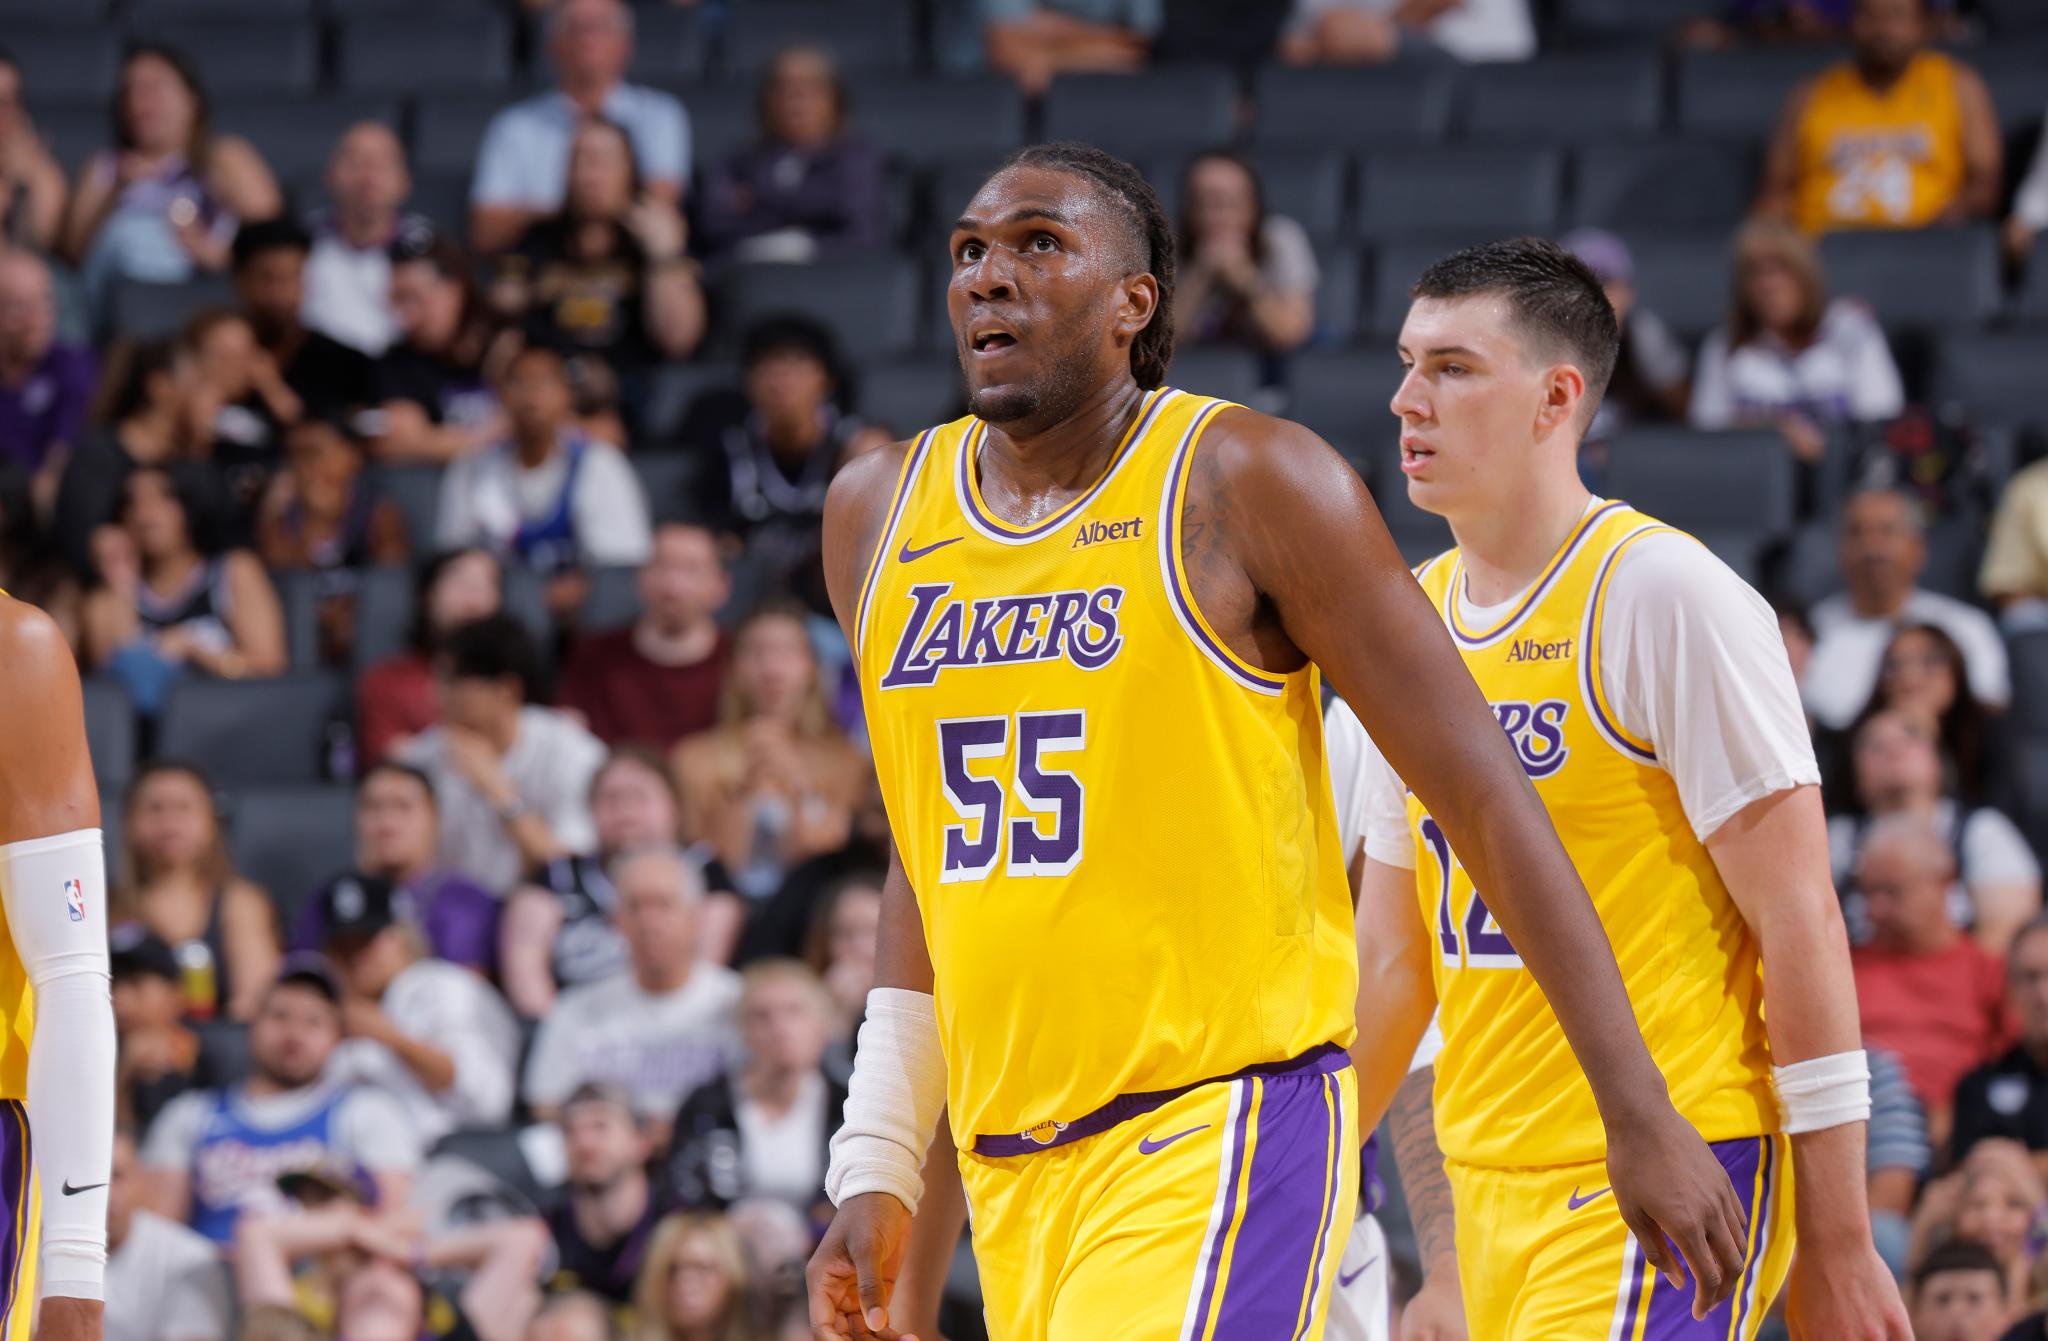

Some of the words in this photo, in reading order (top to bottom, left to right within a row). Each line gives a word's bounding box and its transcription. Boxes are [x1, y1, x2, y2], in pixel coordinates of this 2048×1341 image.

[1071, 516, 1143, 549] Albert
[880, 582, 1126, 691] LAKERS
[1505, 638, 1573, 663] Albert
[936, 708, 1086, 884] 55
